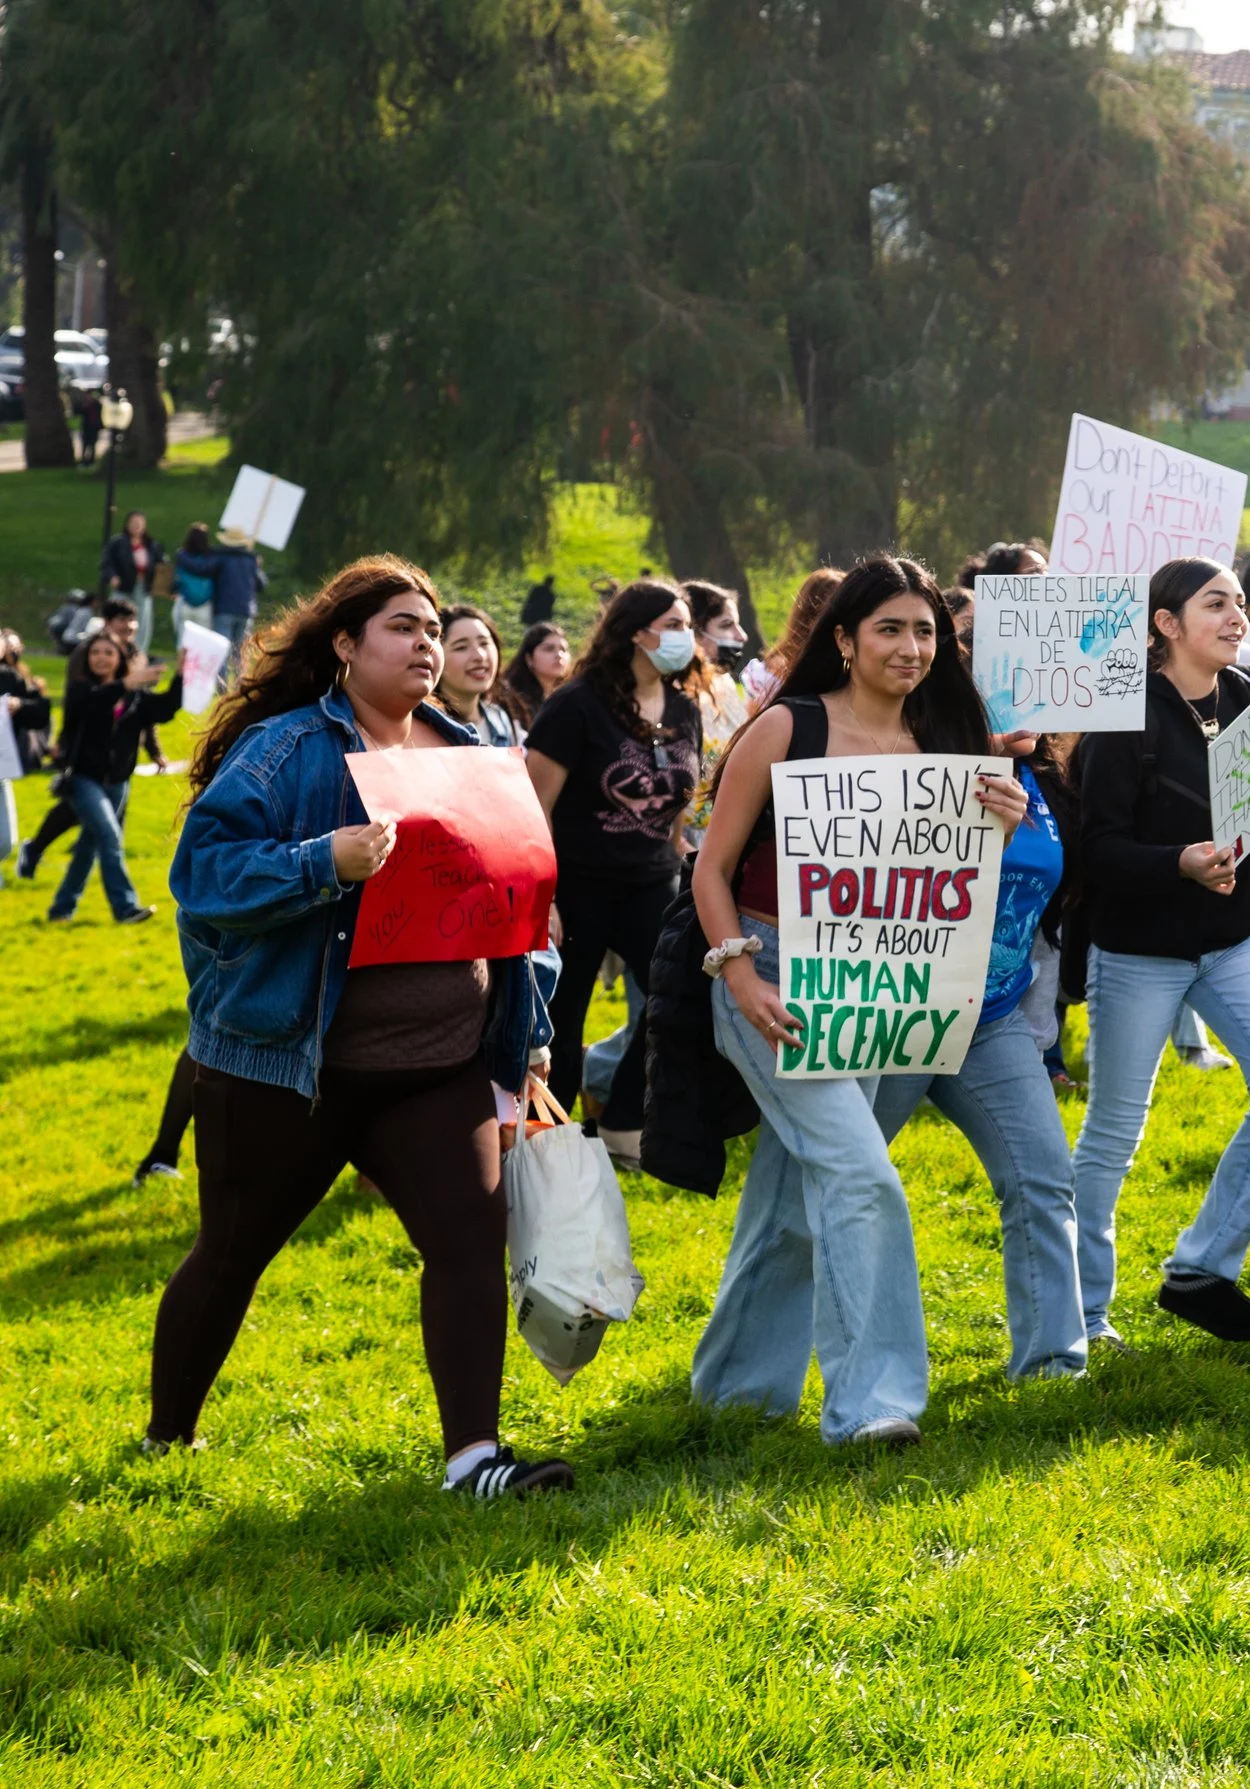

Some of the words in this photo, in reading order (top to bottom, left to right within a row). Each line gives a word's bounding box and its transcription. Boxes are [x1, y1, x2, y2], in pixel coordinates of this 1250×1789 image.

[1074, 419, 1146, 481] Don't
[1129, 485, 1223, 534] LATINA
[981, 576, 1040, 602] NADIE
[1044, 577, 1068, 603] ES
[998, 609, 1030, 637] EN
[1035, 609, 1063, 638] LA
[1064, 609, 1137, 641] TIERRA
[1040, 639, 1066, 664] DE
[1012, 665, 1093, 708] DIOS
[785, 769, 882, 814] THIS
[902, 764, 1004, 820] ISN'T
[784, 816, 883, 858] EVEN
[890, 817, 995, 863] ABOUT
[798, 863, 980, 923] POLITICS
[815, 920, 864, 953] IT'S
[874, 924, 957, 958] ABOUT
[789, 957, 931, 1005] HUMAN
